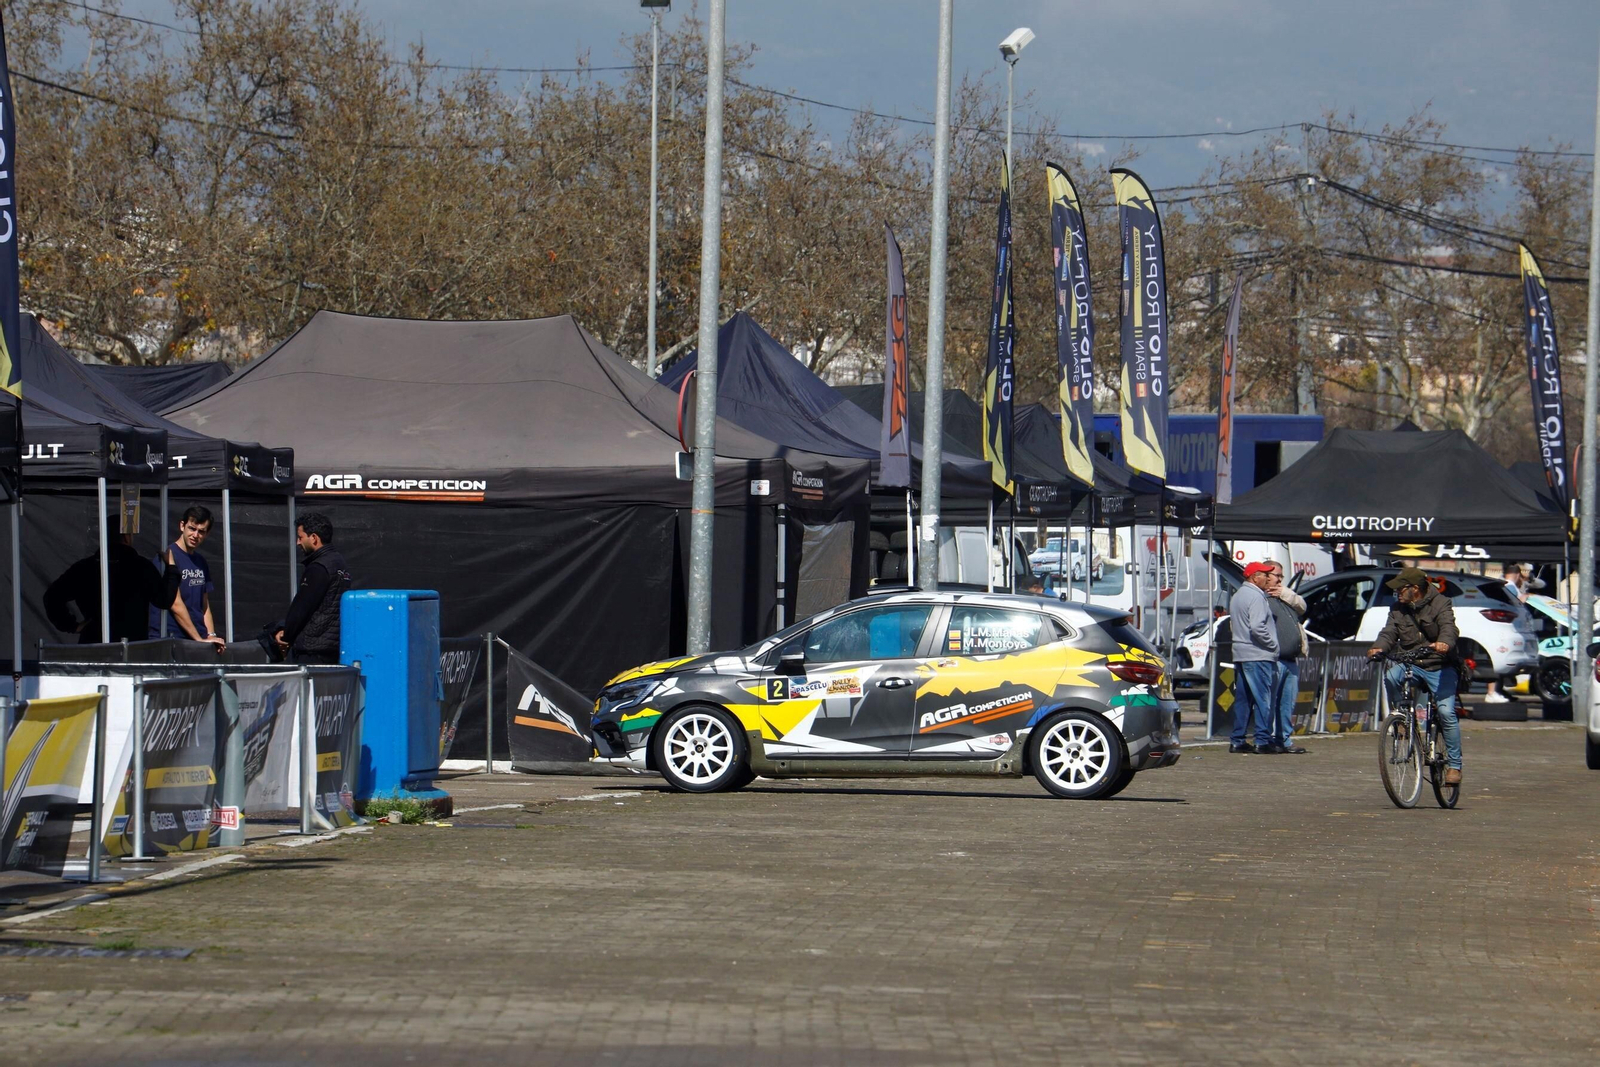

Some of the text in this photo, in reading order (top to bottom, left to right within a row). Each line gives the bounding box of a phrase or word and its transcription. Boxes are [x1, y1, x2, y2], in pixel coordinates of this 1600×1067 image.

[304, 474, 486, 492] AGR COMPETICION
[1312, 515, 1435, 532] CLIOTROPHY
[963, 638, 1027, 650] M.Montoya
[773, 680, 783, 698] 2
[796, 681, 827, 693] PASCELU
[832, 677, 851, 686] RALLY
[920, 691, 1033, 728] AGR COMPETICION
